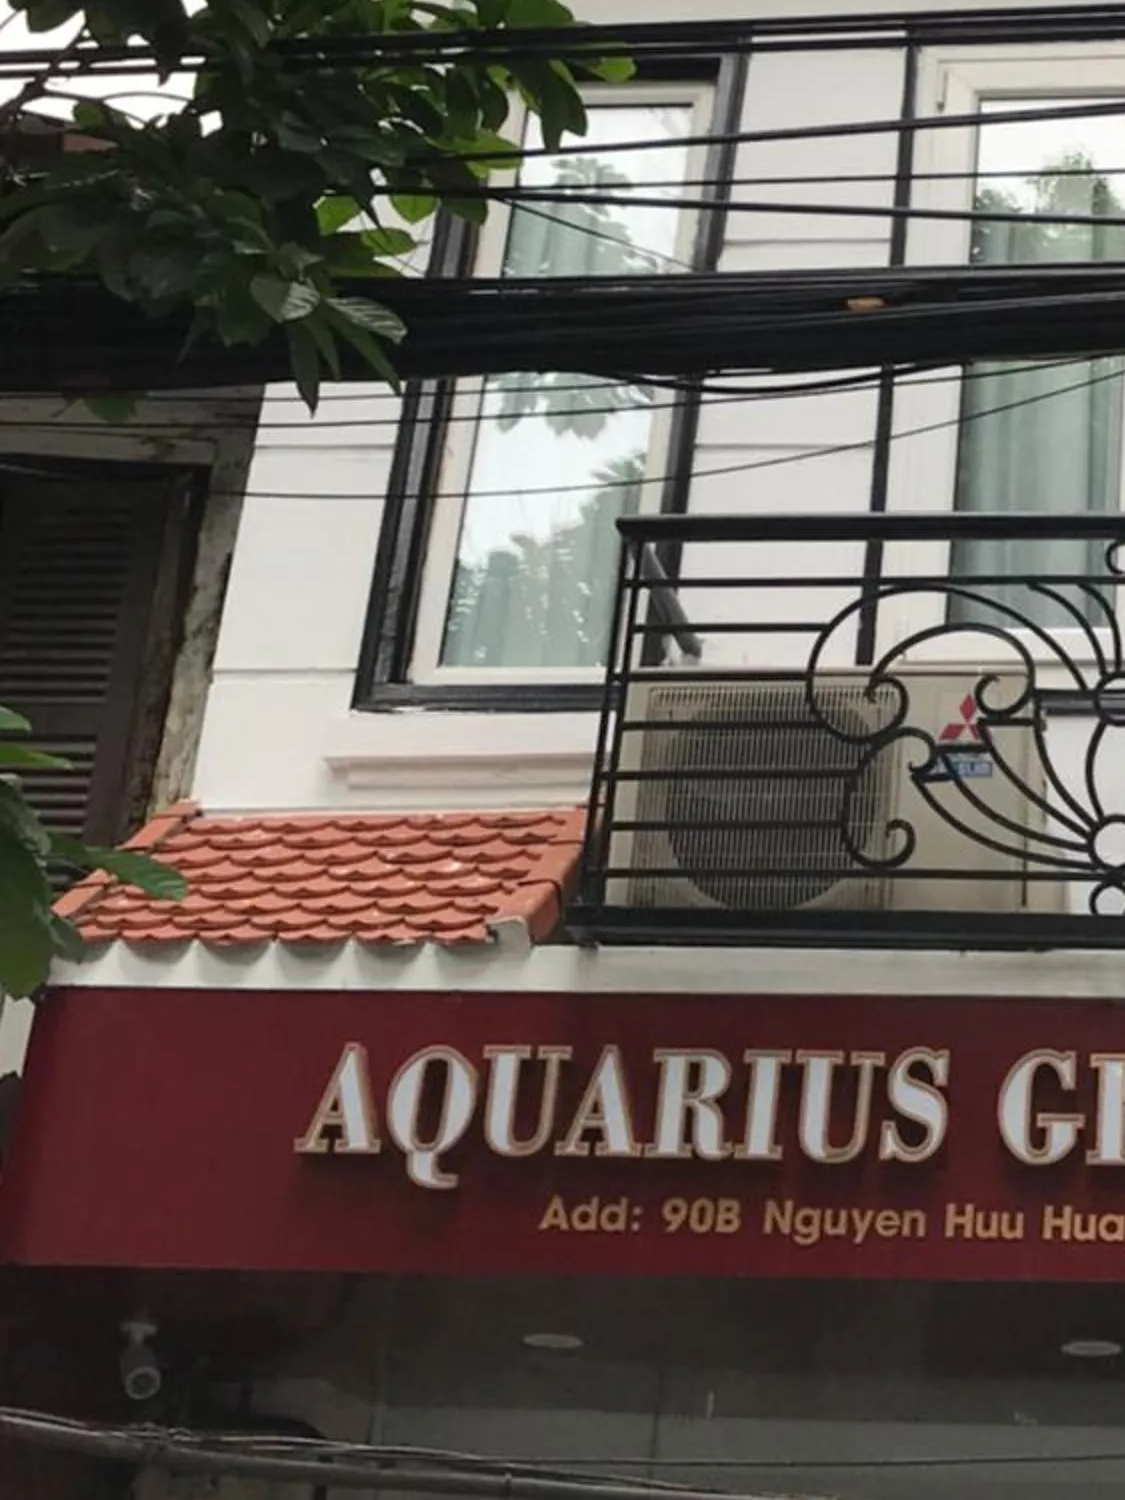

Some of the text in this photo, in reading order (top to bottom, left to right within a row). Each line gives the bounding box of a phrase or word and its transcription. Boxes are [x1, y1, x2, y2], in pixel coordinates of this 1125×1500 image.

[293, 1041, 951, 1190] AQUARIUS
[539, 1196, 642, 1232] Add:
[662, 1198, 741, 1234] 90B
[763, 1200, 927, 1246] Nguyen
[944, 1202, 1025, 1240] Huu
